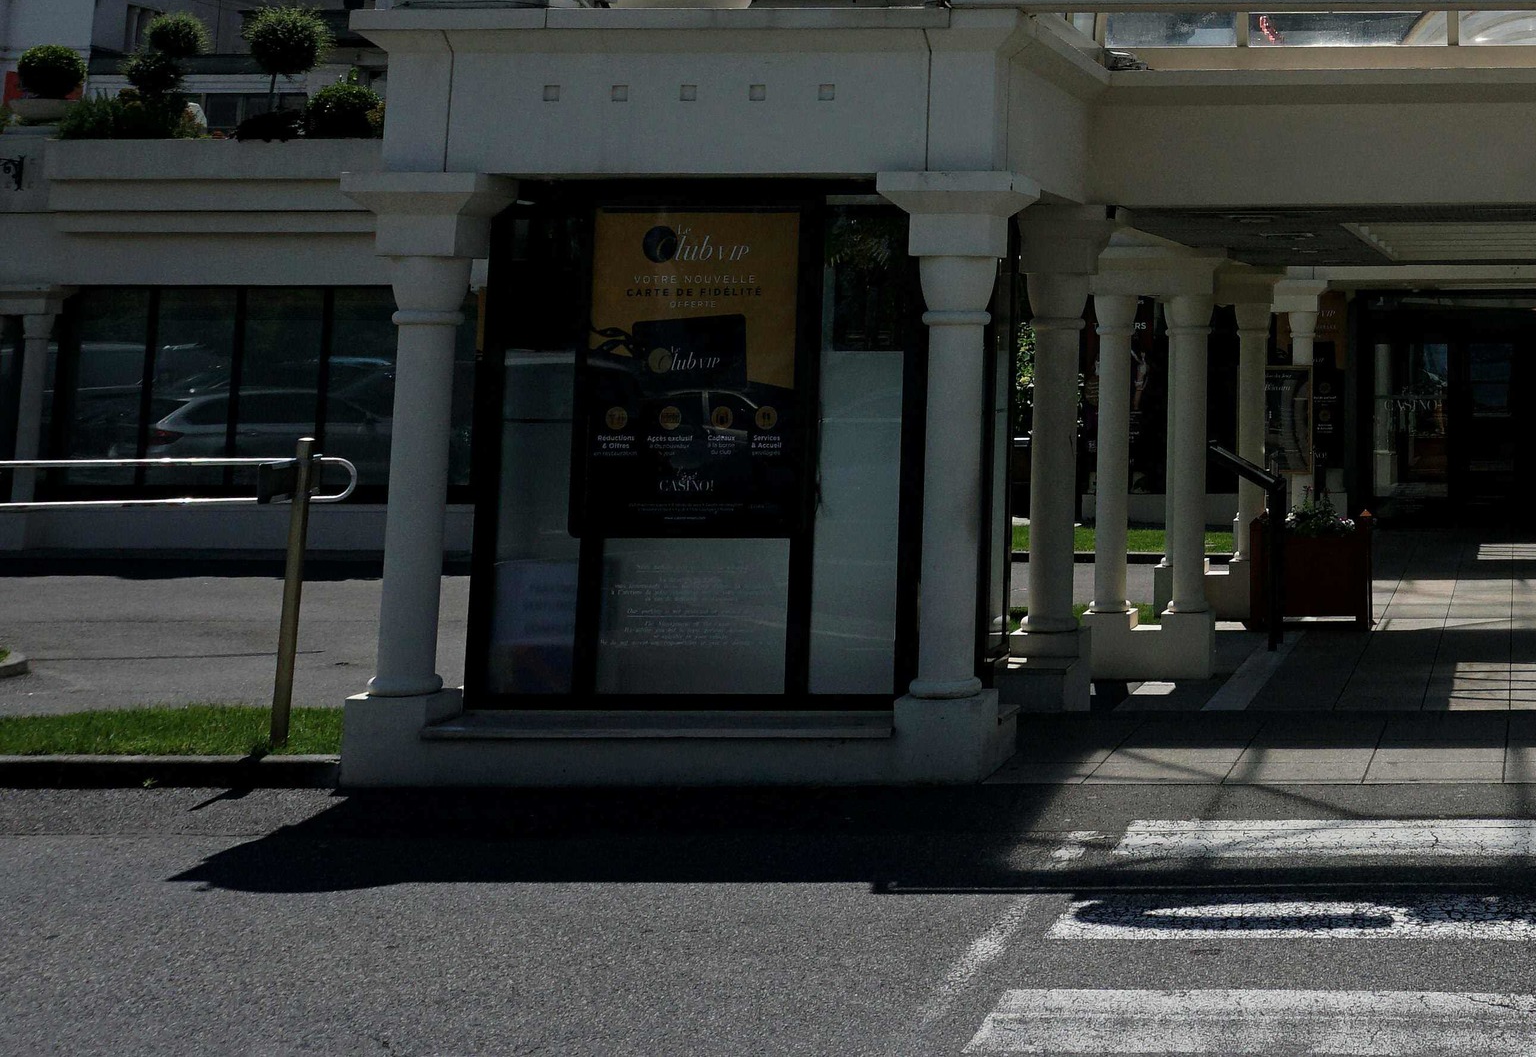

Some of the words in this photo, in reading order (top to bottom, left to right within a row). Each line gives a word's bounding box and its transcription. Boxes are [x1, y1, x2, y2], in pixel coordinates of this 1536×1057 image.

[656, 234, 713, 263] Club
[718, 243, 751, 262] VIP
[633, 275, 678, 285] VOTRE
[684, 275, 756, 285] NOUVELLE
[626, 287, 670, 297] CARTE
[676, 287, 694, 297] DE
[699, 285, 763, 298] FIDÉLITÉ
[669, 300, 717, 310] OFFERTE
[668, 433, 694, 443] exclusif
[753, 433, 781, 442] Services
[757, 441, 783, 449] Accueil
[659, 479, 715, 492] CASINO!
